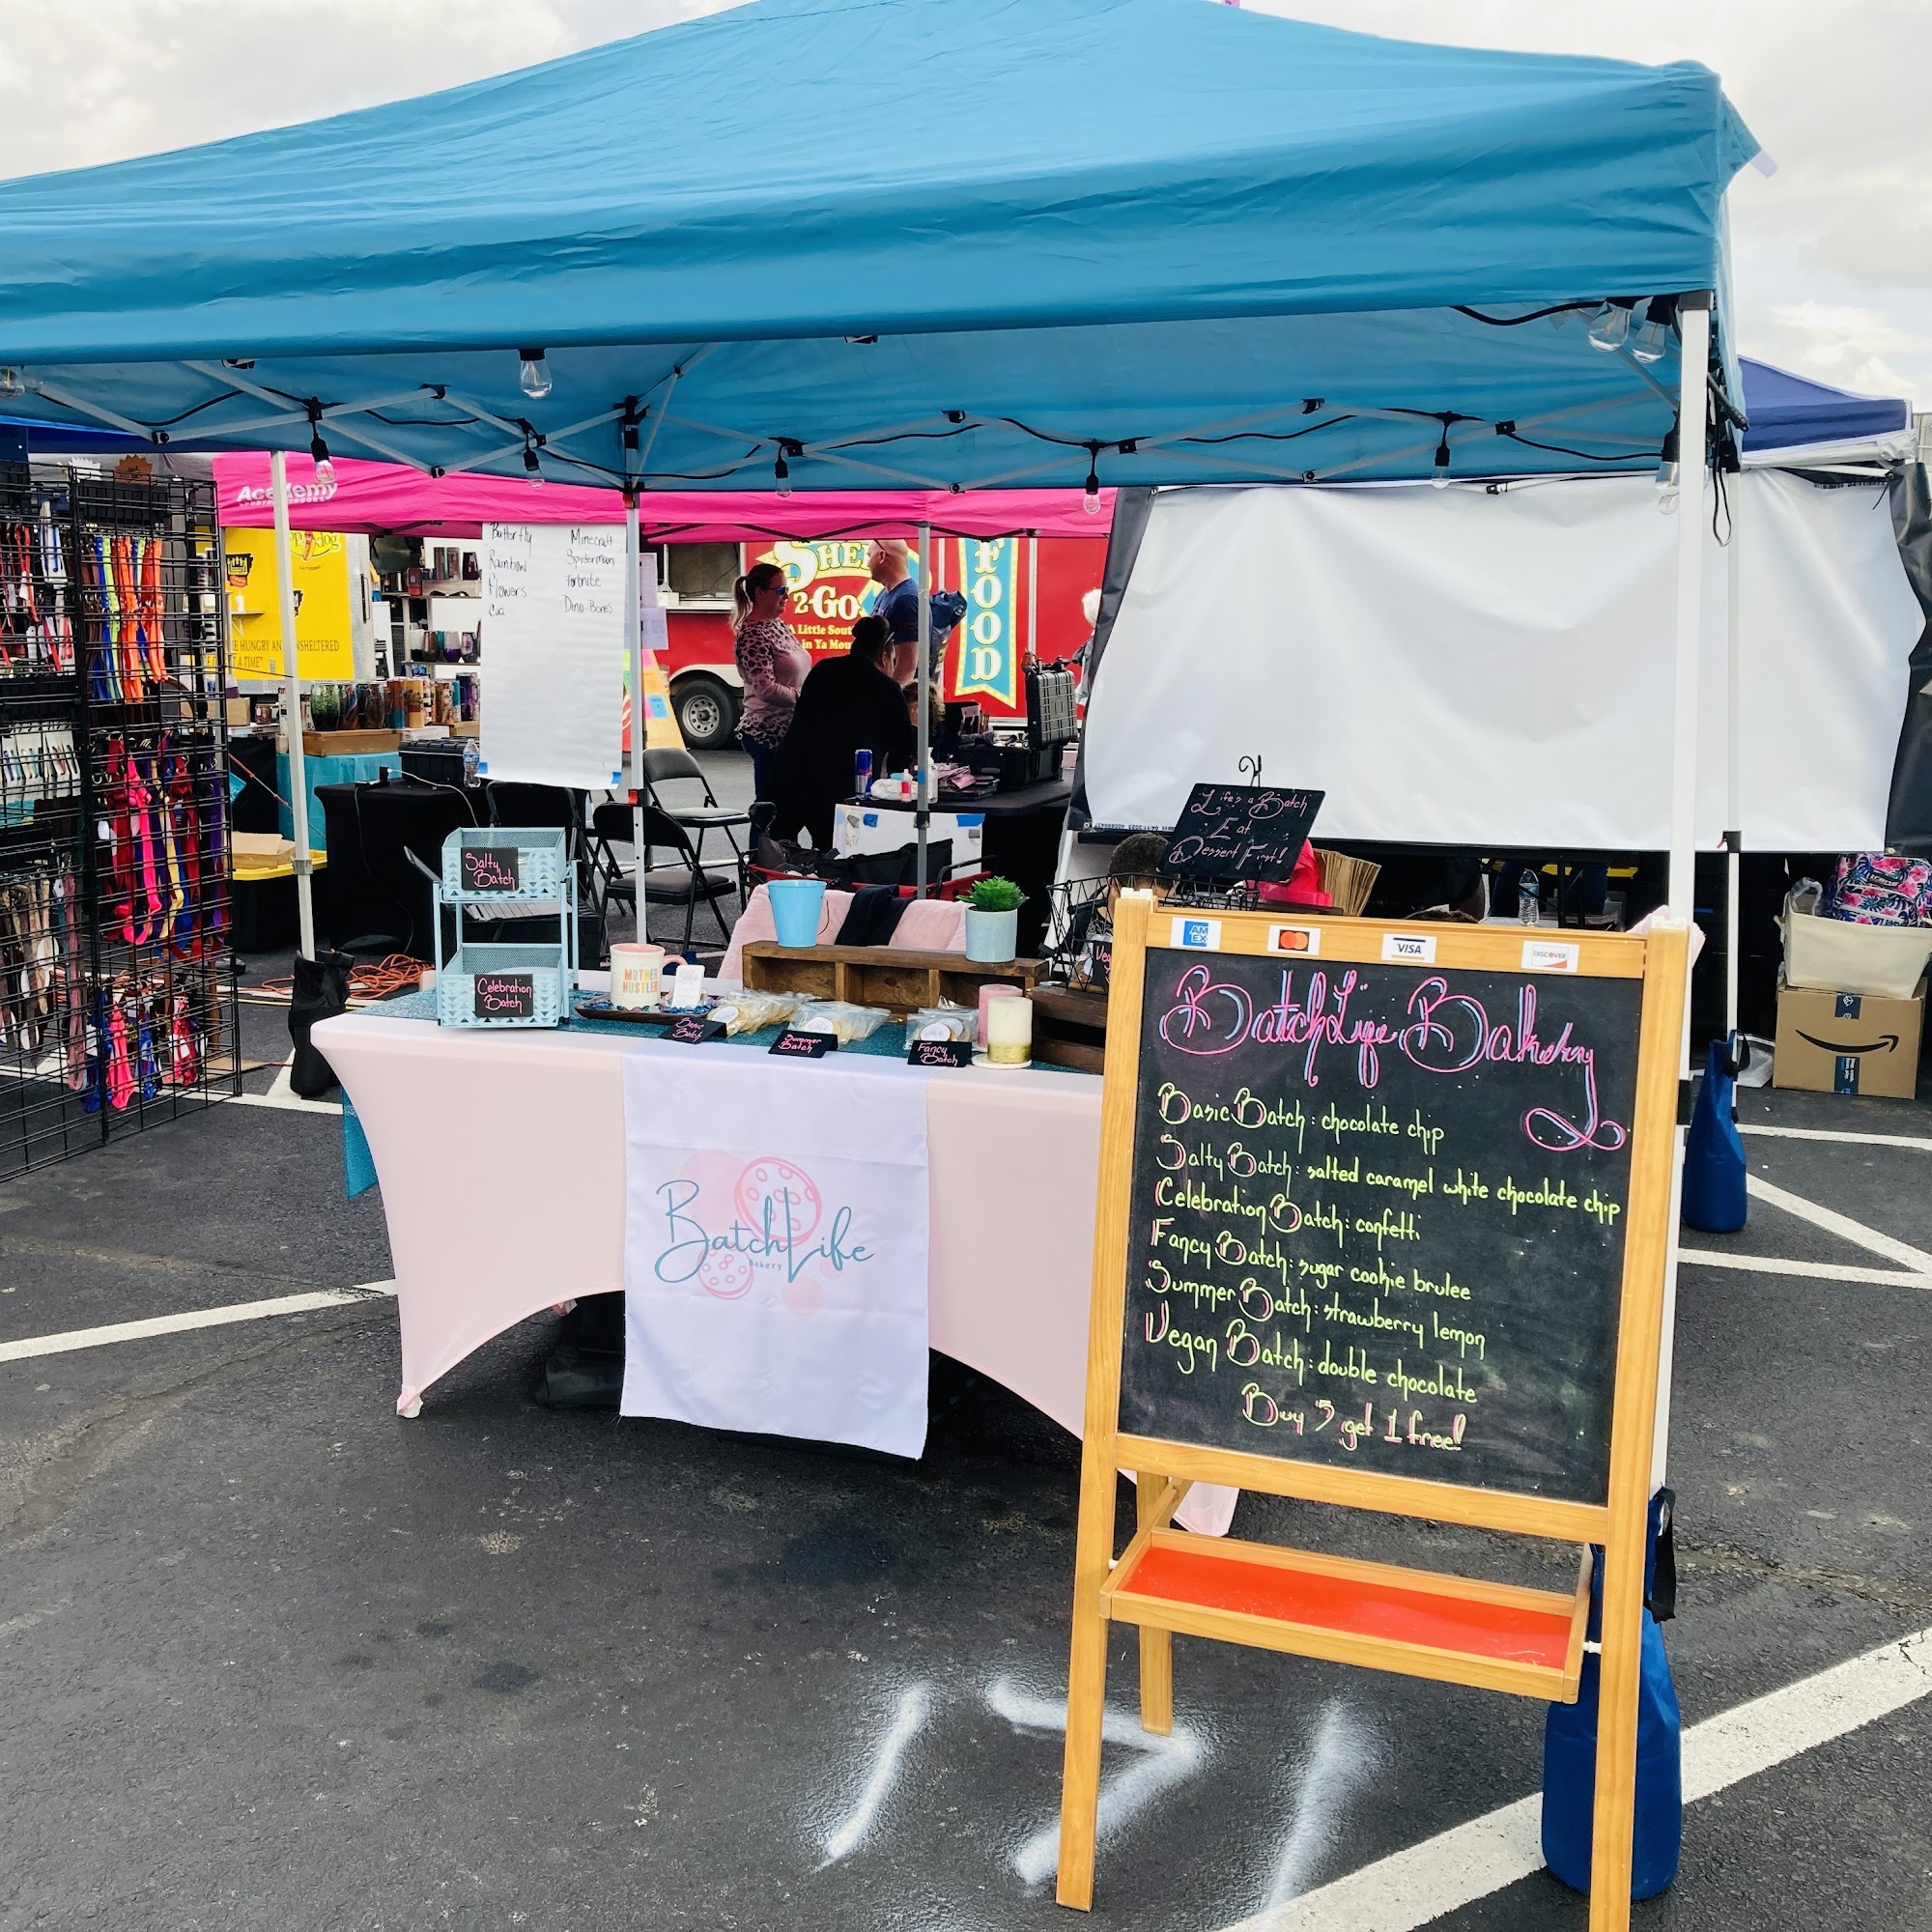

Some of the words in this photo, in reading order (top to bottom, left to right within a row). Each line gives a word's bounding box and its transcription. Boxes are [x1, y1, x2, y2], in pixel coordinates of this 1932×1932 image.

[490, 522, 532, 556] Butterfly
[571, 527, 613, 548] Minecraft
[489, 550, 527, 572] Rainbow
[566, 549, 615, 569] Spiderman
[489, 573, 527, 598] Flowers
[970, 538, 1005, 681] FOOD
[797, 623, 826, 636] Little
[827, 624, 854, 636] Sout
[240, 639, 270, 652] HUNGRY
[271, 639, 284, 652] AN
[296, 639, 340, 652] NSHELTERED
[801, 639, 813, 650] in
[814, 639, 828, 650] Ya
[829, 639, 851, 650] Mou
[1248, 790, 1308, 820] Batch
[1208, 816, 1254, 840] Eat
[1168, 835, 1242, 865] Dessert
[465, 852, 500, 871] Salty
[472, 867, 516, 891] Batch
[1189, 924, 1208, 935] AM
[1191, 934, 1208, 943] EX
[1397, 943, 1422, 954] VISA
[1533, 950, 1567, 959] DISCOVER
[624, 968, 658, 981] MOTHER
[477, 977, 532, 999] Celebration
[622, 980, 659, 994] HUSTLER
[483, 994, 523, 1014] Batch
[778, 1040, 813, 1054] Batch
[783, 1033, 823, 1045] Summer
[918, 1041, 949, 1059] Fancy
[920, 1053, 959, 1067] Batch
[1399, 976, 1627, 1151] Bakery
[1158, 1082, 1231, 1125] Basic
[1321, 1101, 1400, 1145] chocolate
[1407, 1108, 1445, 1156] chip
[1156, 1133, 1224, 1181] Salty
[1307, 1154, 1359, 1182] salted
[1366, 1166, 1434, 1201] caramel
[1443, 1167, 1489, 1206] white
[1497, 1175, 1578, 1216] chocolate
[1583, 1188, 1621, 1226] chip
[1153, 1177, 1267, 1236] Celebration
[1355, 1208, 1422, 1252] confetti
[749, 1258, 783, 1271] Bakery
[1150, 1217, 1211, 1270] Fancy
[1298, 1258, 1345, 1290] sugar
[1350, 1257, 1406, 1297] cookie
[1413, 1268, 1471, 1300] brulee
[1145, 1260, 1236, 1314] Summer
[1323, 1292, 1424, 1350] strawberry
[1434, 1310, 1486, 1360] lemon
[1145, 1299, 1218, 1376] Vegan
[1318, 1339, 1378, 1384] double
[1387, 1358, 1478, 1404] chocolate
[1241, 1382, 1304, 1436] Buy
[1339, 1402, 1374, 1452] get
[1383, 1407, 1404, 1444] 1
[1406, 1409, 1467, 1451] free!
